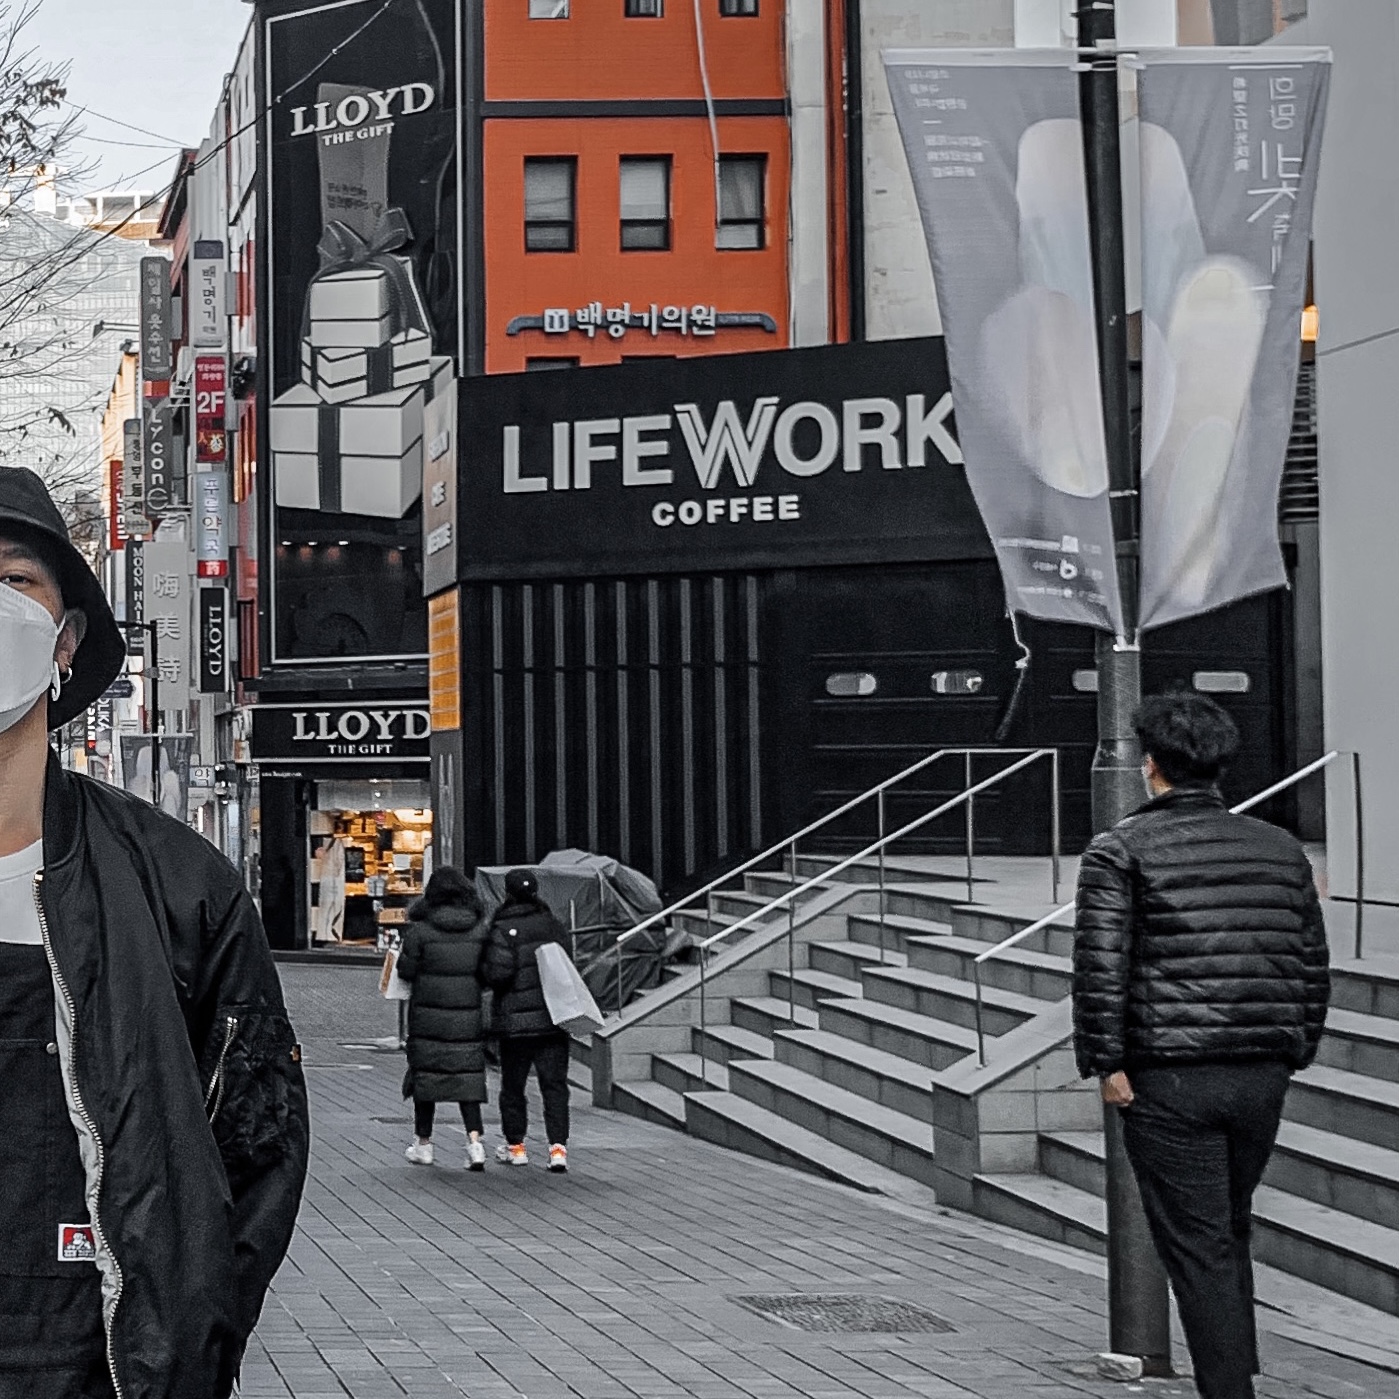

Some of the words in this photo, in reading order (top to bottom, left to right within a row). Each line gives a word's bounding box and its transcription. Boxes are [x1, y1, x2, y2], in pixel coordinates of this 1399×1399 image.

[290, 82, 435, 137] LLOYD
[322, 130, 354, 146] THE
[356, 122, 395, 140] GIFT
[576, 301, 716, 338] 백명기의원
[196, 391, 225, 414] 2F
[651, 494, 800, 527] COFFEE
[132, 547, 144, 588] MOON
[208, 606, 223, 676] LLOYD
[292, 709, 432, 741] LLOYD
[328, 744, 356, 754] THE
[358, 744, 393, 754] GIFT
